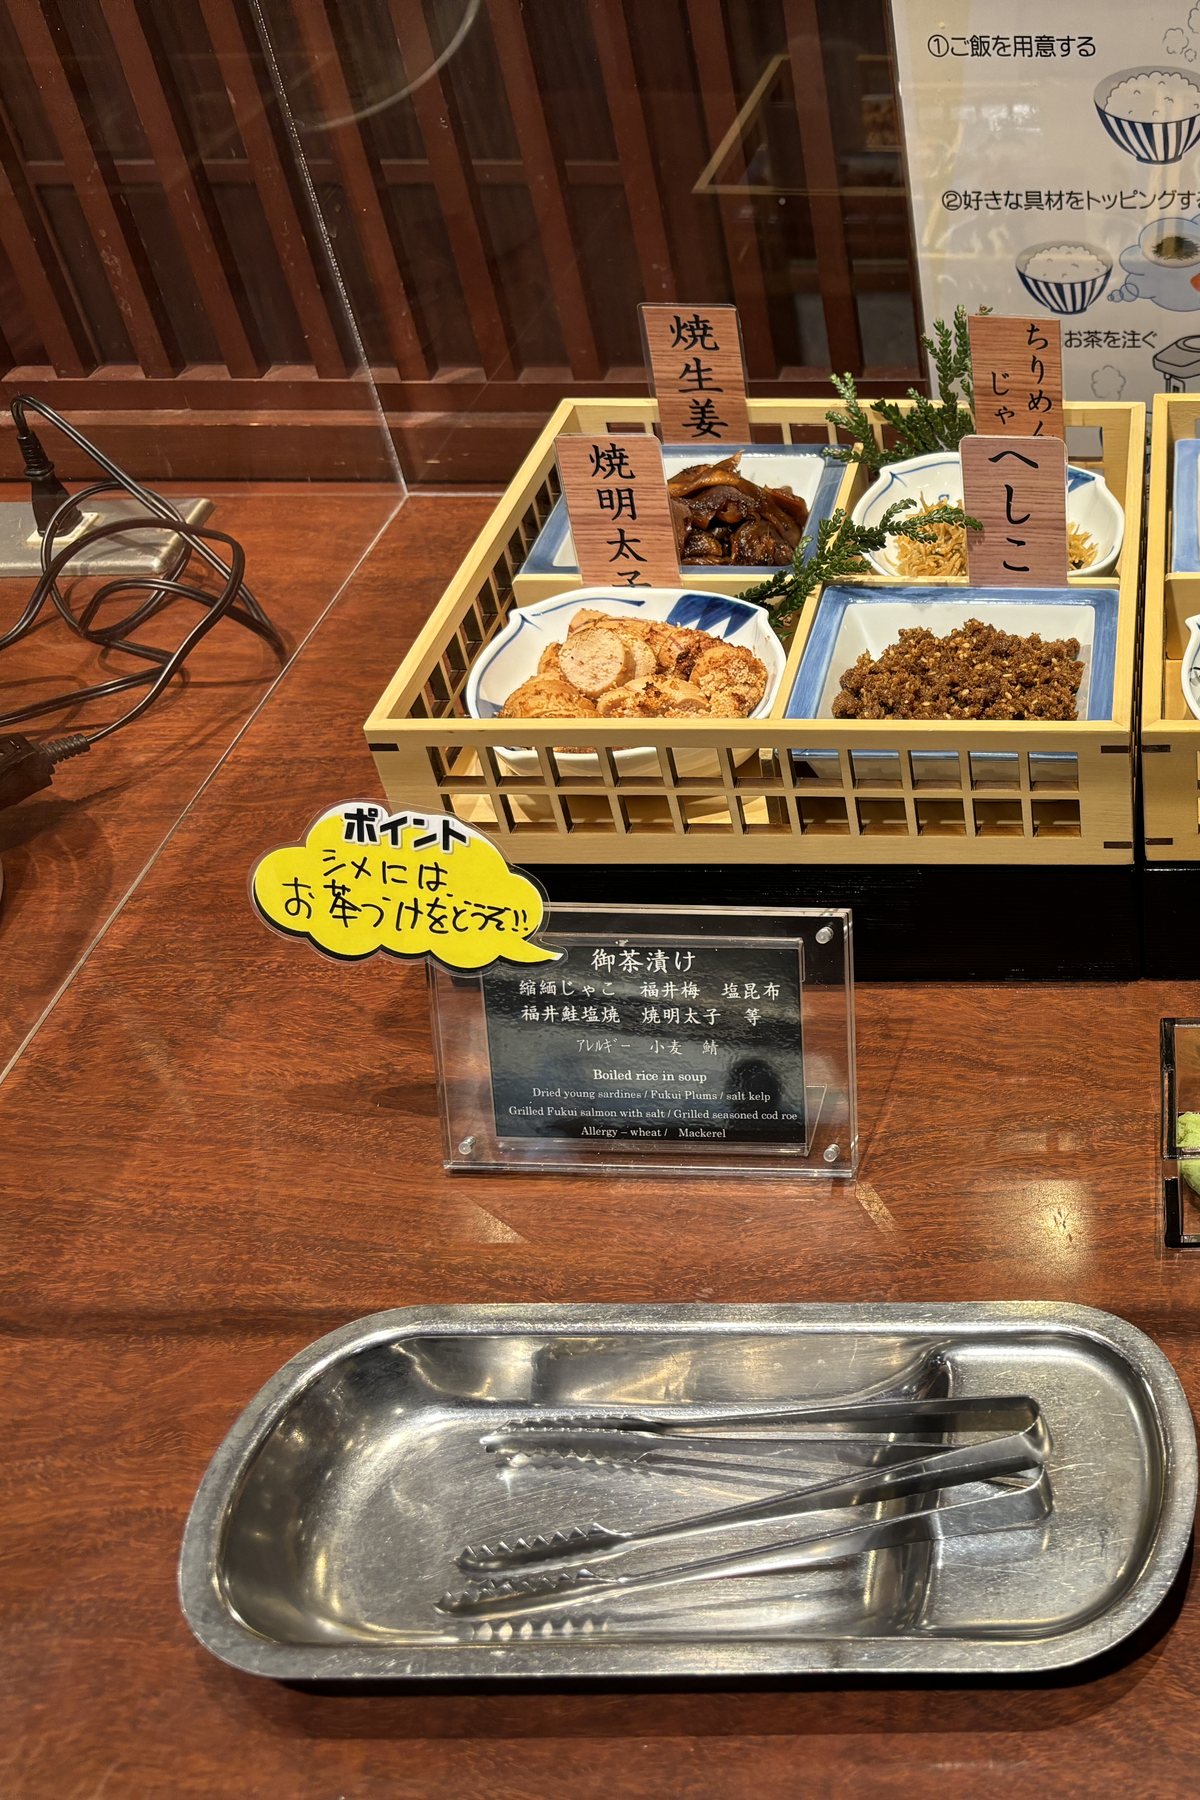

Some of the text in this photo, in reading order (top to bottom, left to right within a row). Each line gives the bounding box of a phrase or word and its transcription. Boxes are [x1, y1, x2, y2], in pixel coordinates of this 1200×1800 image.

[928, 34, 1097, 58] ①ご飯を用意する
[670, 314, 729, 439] 焼生姜
[987, 449, 1040, 572] へしこ
[343, 807, 467, 851] ポイント
[590, 948, 696, 973] 御茶漬け
[519, 979, 781, 1001] 縮緬じゃこ 福井梅 塩昆布
[520, 1004, 762, 1027] 福井鮭塩焼 焼明太子 等
[649, 1039, 683, 1055] 小麦
[702, 1039, 719, 1055] 鯖
[593, 1069, 707, 1084] Boiled rice in soup
[532, 1087, 561, 1098] Dried
[564, 1090, 595, 1100] young
[598, 1089, 642, 1099] sardines
[651, 1090, 682, 1100] Fukui
[684, 1090, 718, 1100] Plums
[726, 1091, 746, 1101] salt
[749, 1091, 771, 1102] kelp
[508, 1106, 545, 1116] Grilled
[547, 1106, 578, 1116] Fukui
[580, 1108, 617, 1117] salmon
[619, 1108, 643, 1118] with
[645, 1109, 665, 1118] salt
[673, 1109, 710, 1119] Grilled
[712, 1110, 759, 1120] seasoned
[761, 1110, 779, 1120] cod
[581, 1126, 618, 1137] Allergy
[630, 1127, 662, 1137] wheat
[678, 1127, 727, 1138] Mackerel
